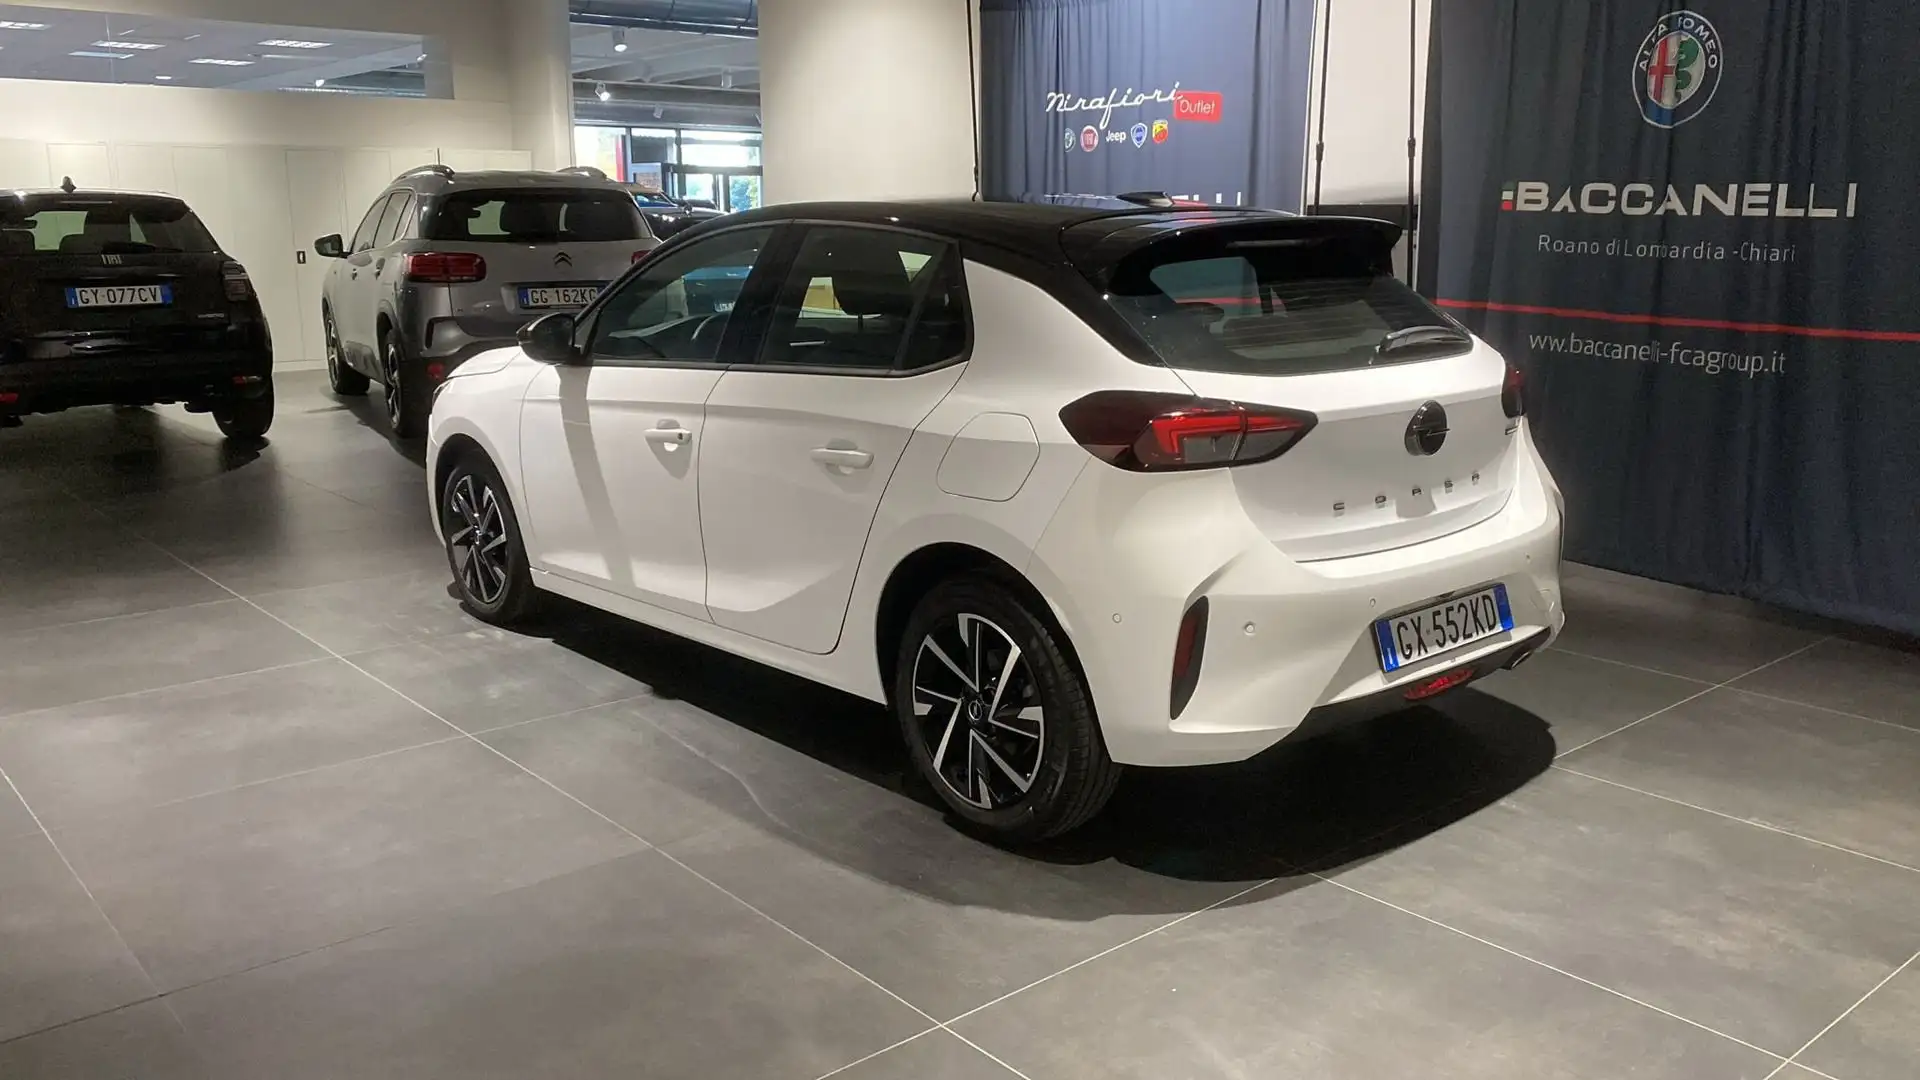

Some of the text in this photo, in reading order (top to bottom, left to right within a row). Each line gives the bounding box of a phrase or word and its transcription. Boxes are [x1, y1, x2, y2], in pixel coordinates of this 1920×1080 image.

[1179, 99, 1216, 115] Outlet
[1105, 130, 1127, 144] Jeep
[1515, 182, 1855, 217] BACCANELLI
[1432, 593, 1498, 650] 552KD
